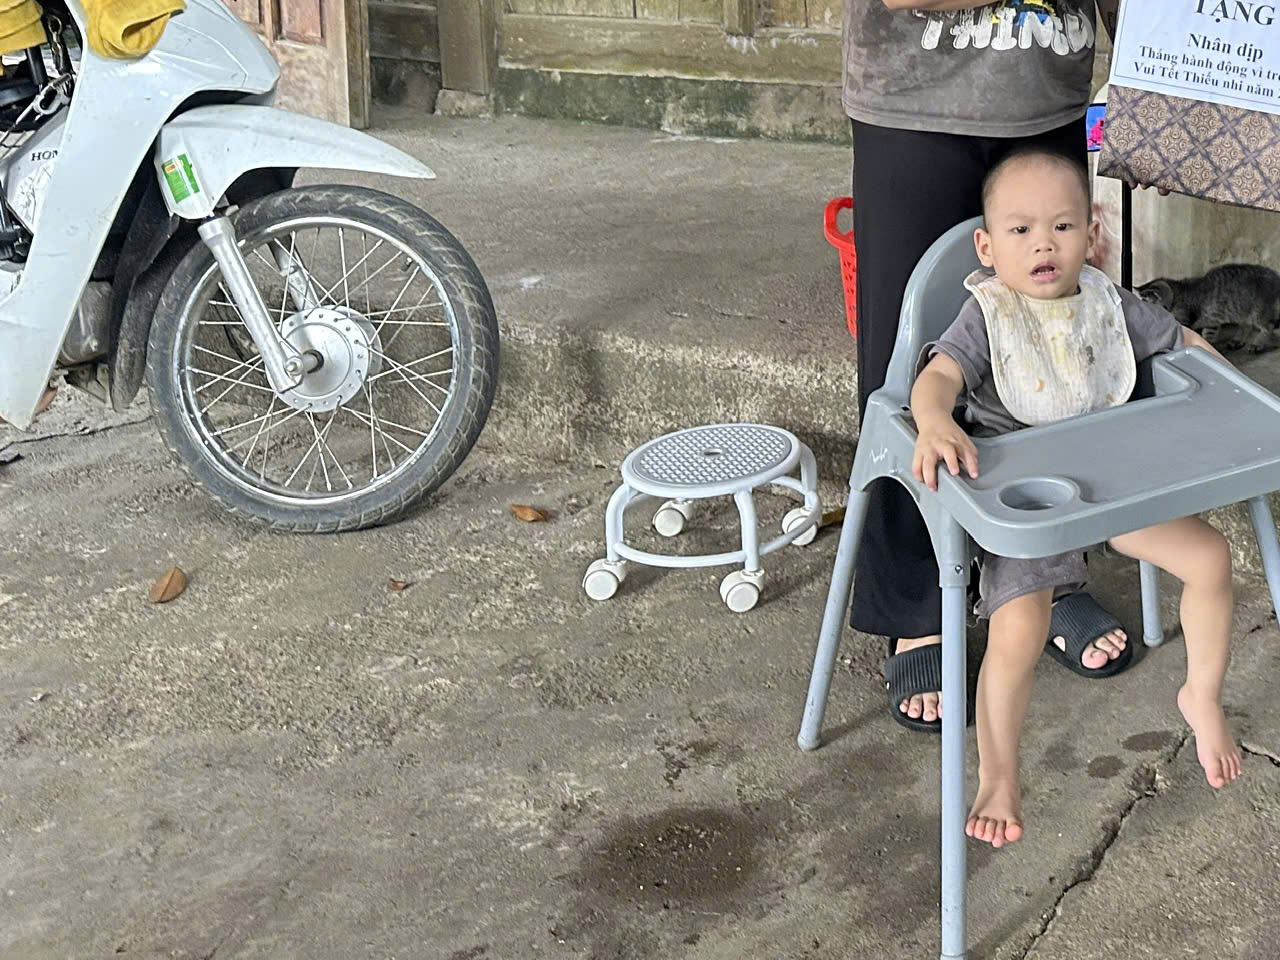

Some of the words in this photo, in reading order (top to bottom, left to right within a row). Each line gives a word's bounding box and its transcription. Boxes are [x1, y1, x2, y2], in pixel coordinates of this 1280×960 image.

[1139, 45, 1178, 65] Tháng
[1181, 53, 1213, 70] hành
[1216, 61, 1248, 79] động
[1252, 65, 1264, 78] vì
[1187, 33, 1232, 55] Nhân
[1236, 41, 1264, 63] dịp
[1133, 61, 1156, 75] Vui
[1159, 63, 1179, 80] Tết
[1183, 70, 1219, 87] Thiếu
[1222, 79, 1243, 92] nhi
[1246, 83, 1274, 98] năm
